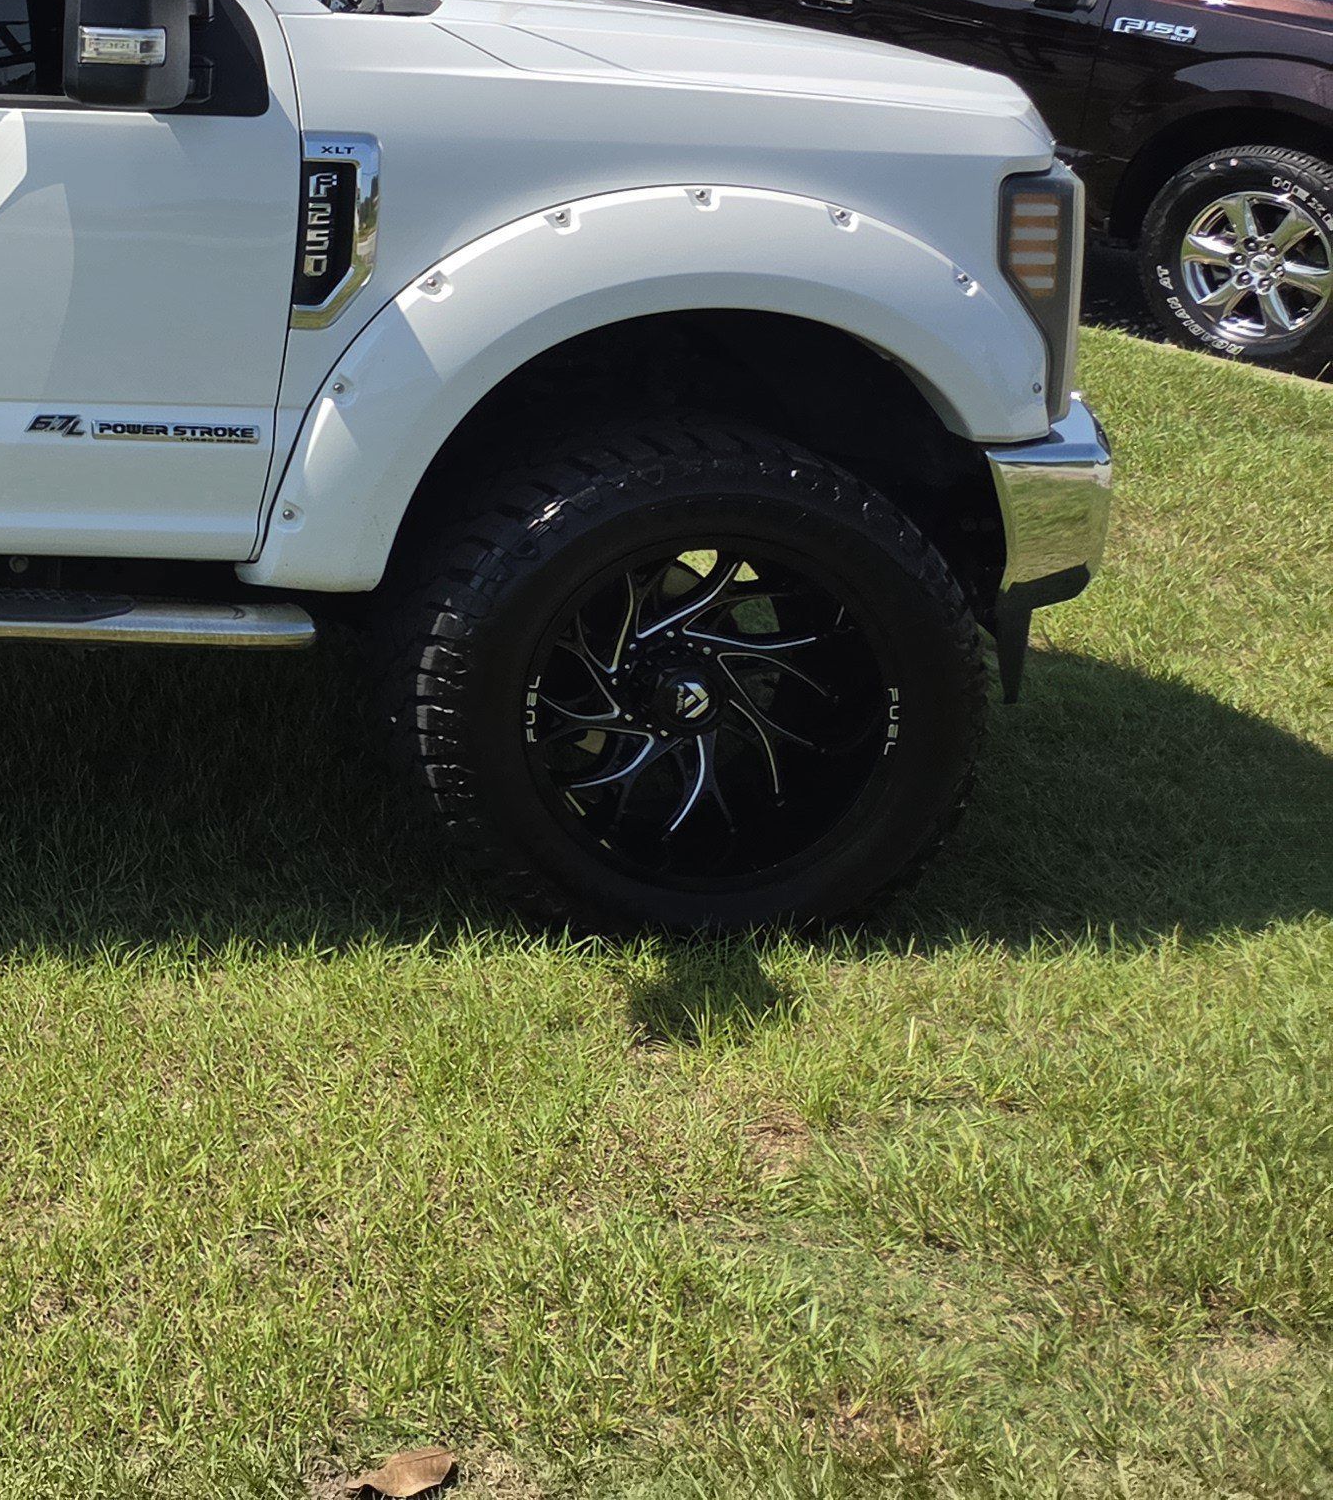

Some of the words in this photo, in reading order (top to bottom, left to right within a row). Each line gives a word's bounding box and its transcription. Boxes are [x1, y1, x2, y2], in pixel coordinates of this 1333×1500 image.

[321, 146, 355, 155] XLT
[303, 172, 338, 278] F250
[98, 422, 169, 436] POWER
[173, 424, 255, 439] STROKE
[525, 675, 541, 743] FUEL
[883, 687, 900, 756] FUEL
